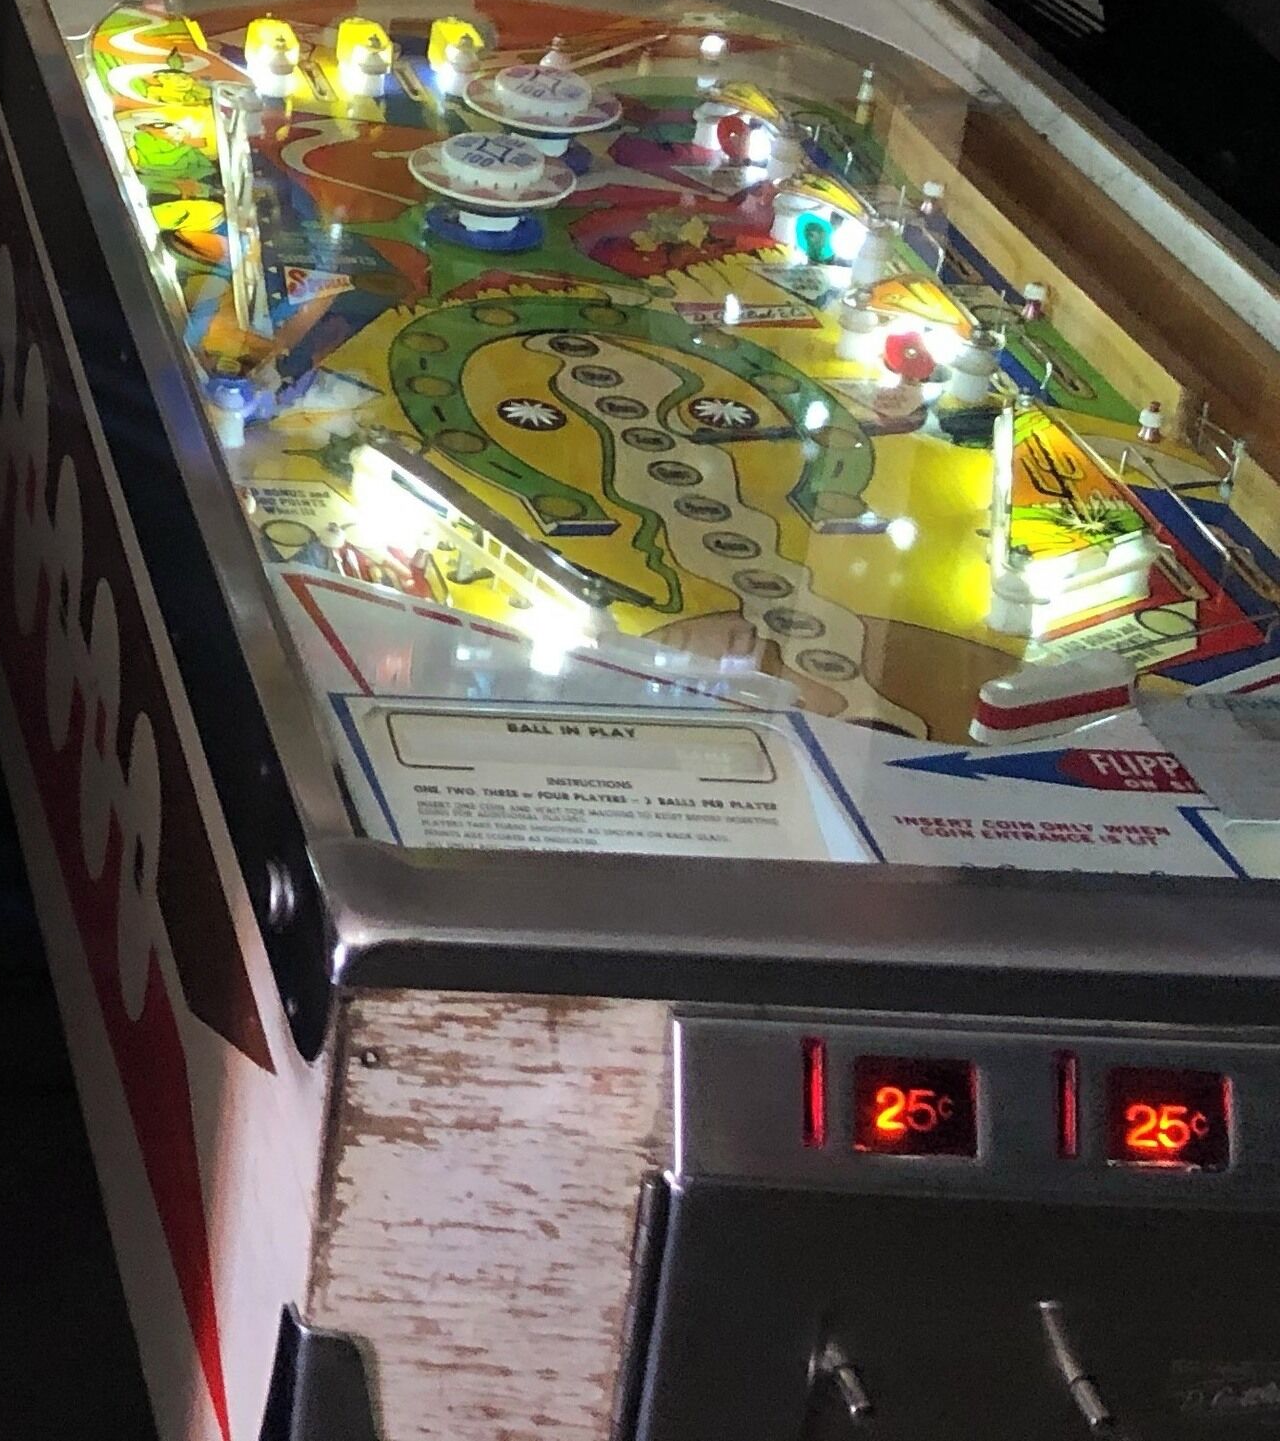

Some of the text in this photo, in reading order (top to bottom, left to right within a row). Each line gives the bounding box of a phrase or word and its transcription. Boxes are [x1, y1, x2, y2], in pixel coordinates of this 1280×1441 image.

[506, 722, 638, 740] BALL IN PLAY
[546, 776, 634, 790] INSTRUCTIONS
[892, 815, 1172, 838] INSERT COIN ONLY WHEN
[920, 826, 976, 840] COIN
[981, 828, 1096, 845] ENTRANCE
[1125, 834, 1160, 848] LIT
